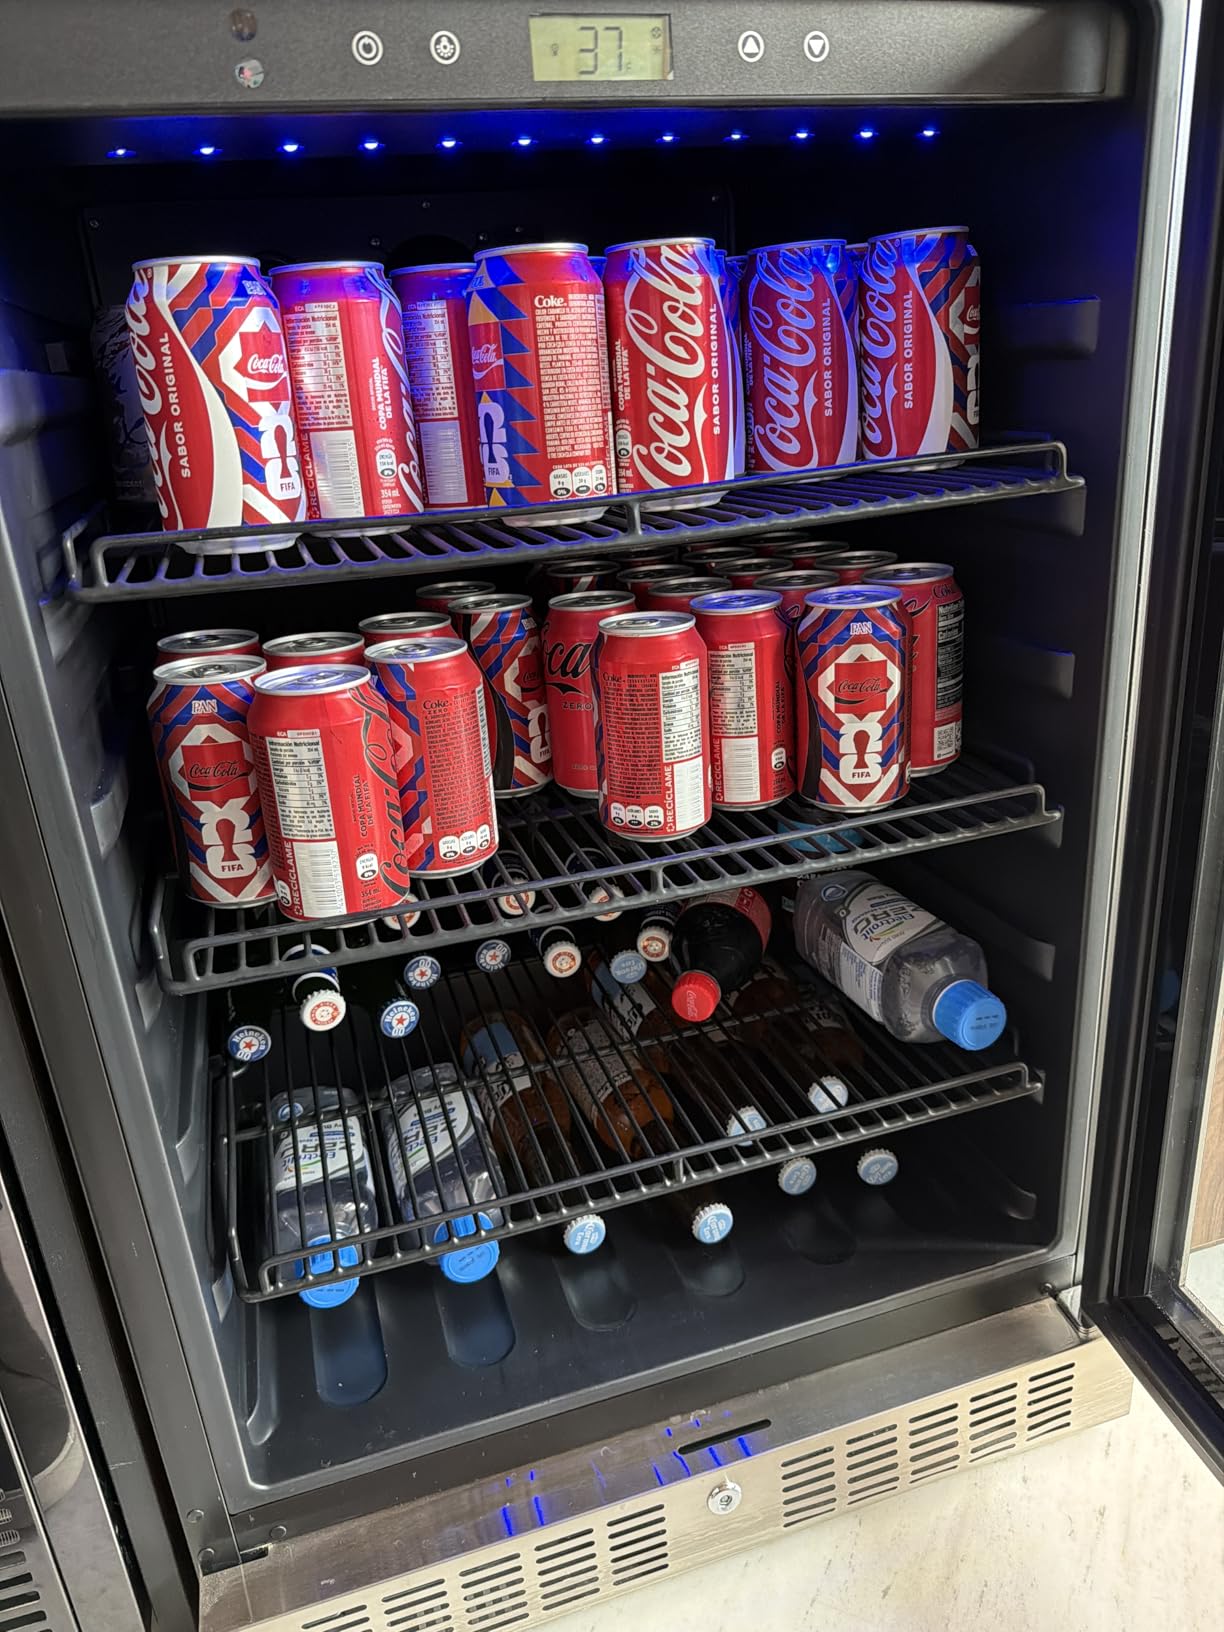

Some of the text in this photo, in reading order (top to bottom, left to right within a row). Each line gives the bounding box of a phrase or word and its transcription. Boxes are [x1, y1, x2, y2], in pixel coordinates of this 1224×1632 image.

[578, 25, 623, 76] 37
[750, 245, 817, 471] Coca-Cola
[822, 298, 833, 417] SABOR ORIGINAL
[861, 239, 898, 460] oca-Cola
[903, 290, 913, 410] SABOR ORIGINAL
[248, 353, 285, 376] Coca-Cola
[614, 339, 625, 388] MUNDIAL
[625, 244, 705, 490] Coca-Cola
[709, 304, 721, 435] SABOR ORIGINAL
[372, 357, 385, 401] MUNDIAL
[380, 368, 389, 389] FIFA
[624, 373, 630, 388] LA
[159, 332, 191, 478] SABOR ORIGINAL
[617, 389, 625, 411] COPA
[625, 388, 631, 400] DE
[378, 402, 388, 430] COPA
[385, 406, 393, 419] DE
[487, 467, 500, 476] FIFA
[279, 482, 297, 493] FIFA
[850, 622, 873, 634] PAN
[838, 678, 881, 694] Coca-Cola
[192, 700, 218, 714] PAN
[562, 702, 593, 711] ZERO
[189, 761, 241, 778] Coca-Cola
[851, 770, 872, 779] FIFA
[354, 775, 364, 812] MUNDIAL
[360, 814, 368, 837] COPA
[367, 814, 374, 826] DE
[221, 863, 244, 873] FIFA
[862, 913, 915, 941] Electrolit
[408, 972, 438, 987] Heineken
[384, 1006, 416, 1022] Heineken
[232, 1029, 266, 1051] Heineken
